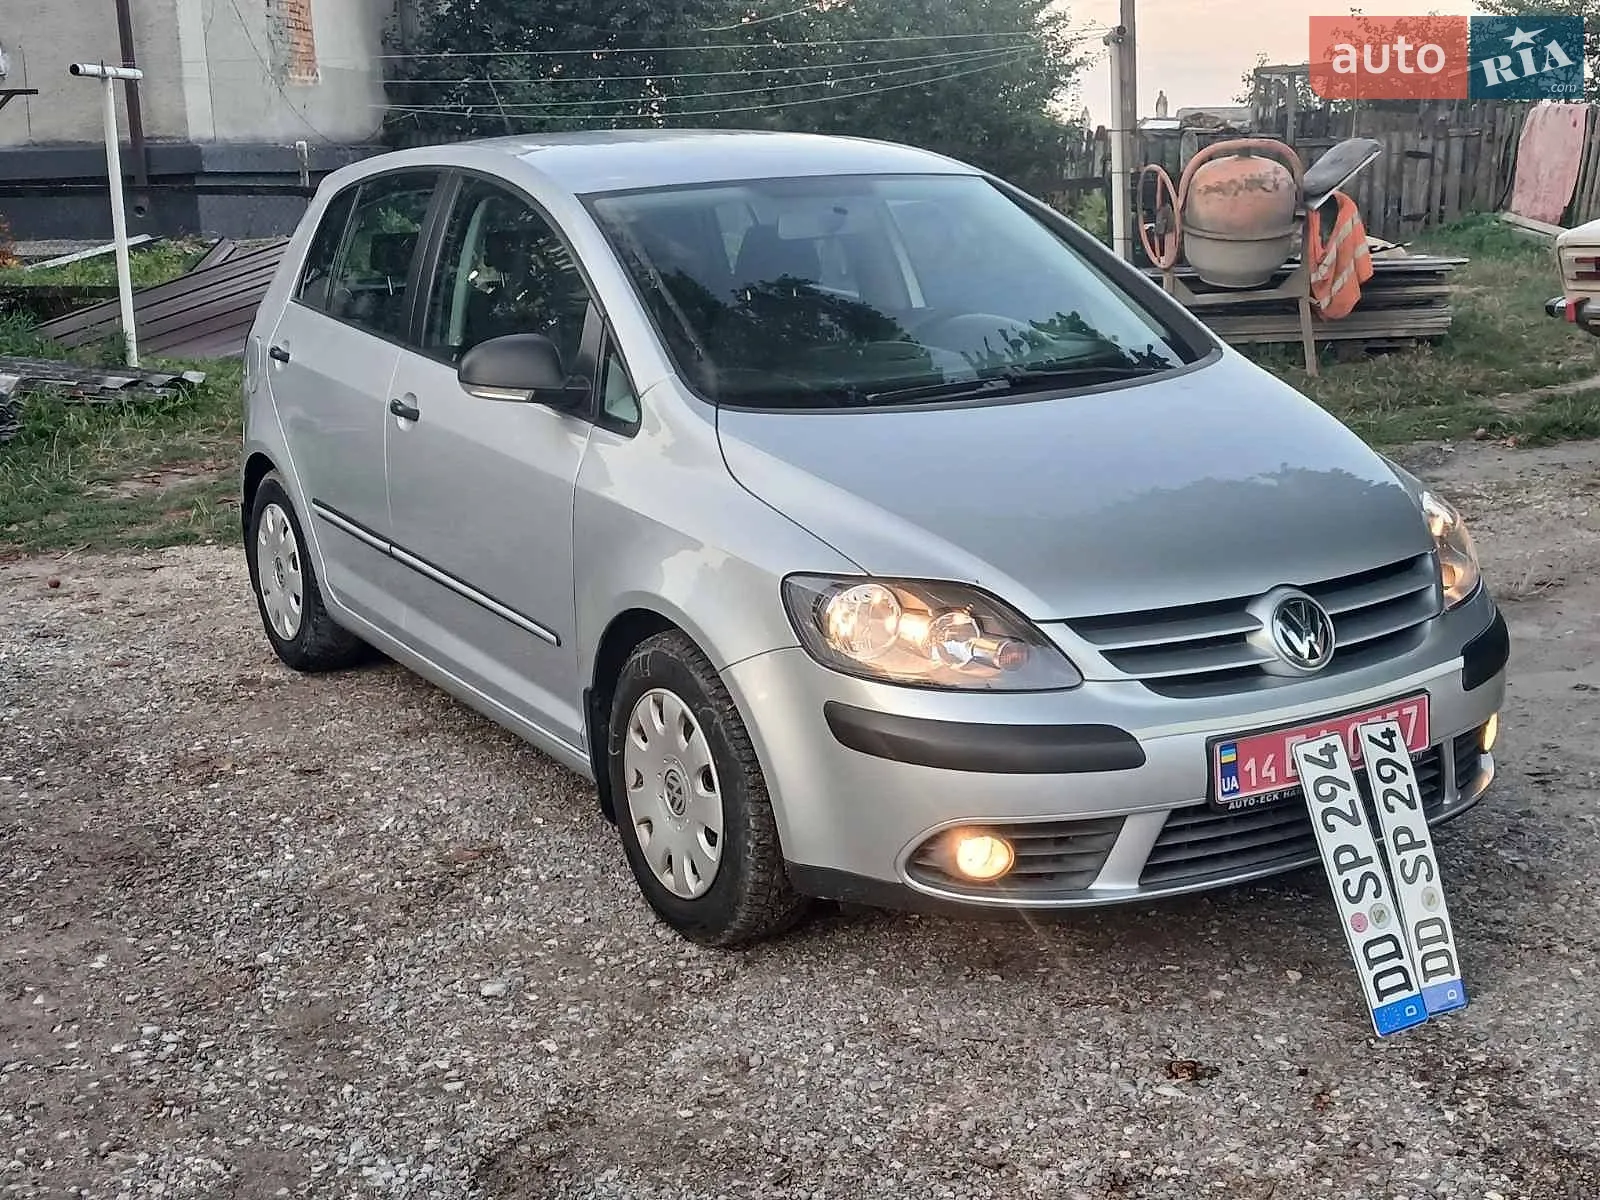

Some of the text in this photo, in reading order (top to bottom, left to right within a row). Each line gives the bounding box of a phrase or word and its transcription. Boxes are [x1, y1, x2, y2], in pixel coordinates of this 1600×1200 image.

[1244, 753, 1277, 787] 14
[1221, 775, 1239, 793] UA
[1368, 727, 1456, 983] DD SP 294
[1303, 743, 1414, 1002] DD SP 294
[1447, 989, 1458, 1000] D
[1404, 1005, 1418, 1017] D
